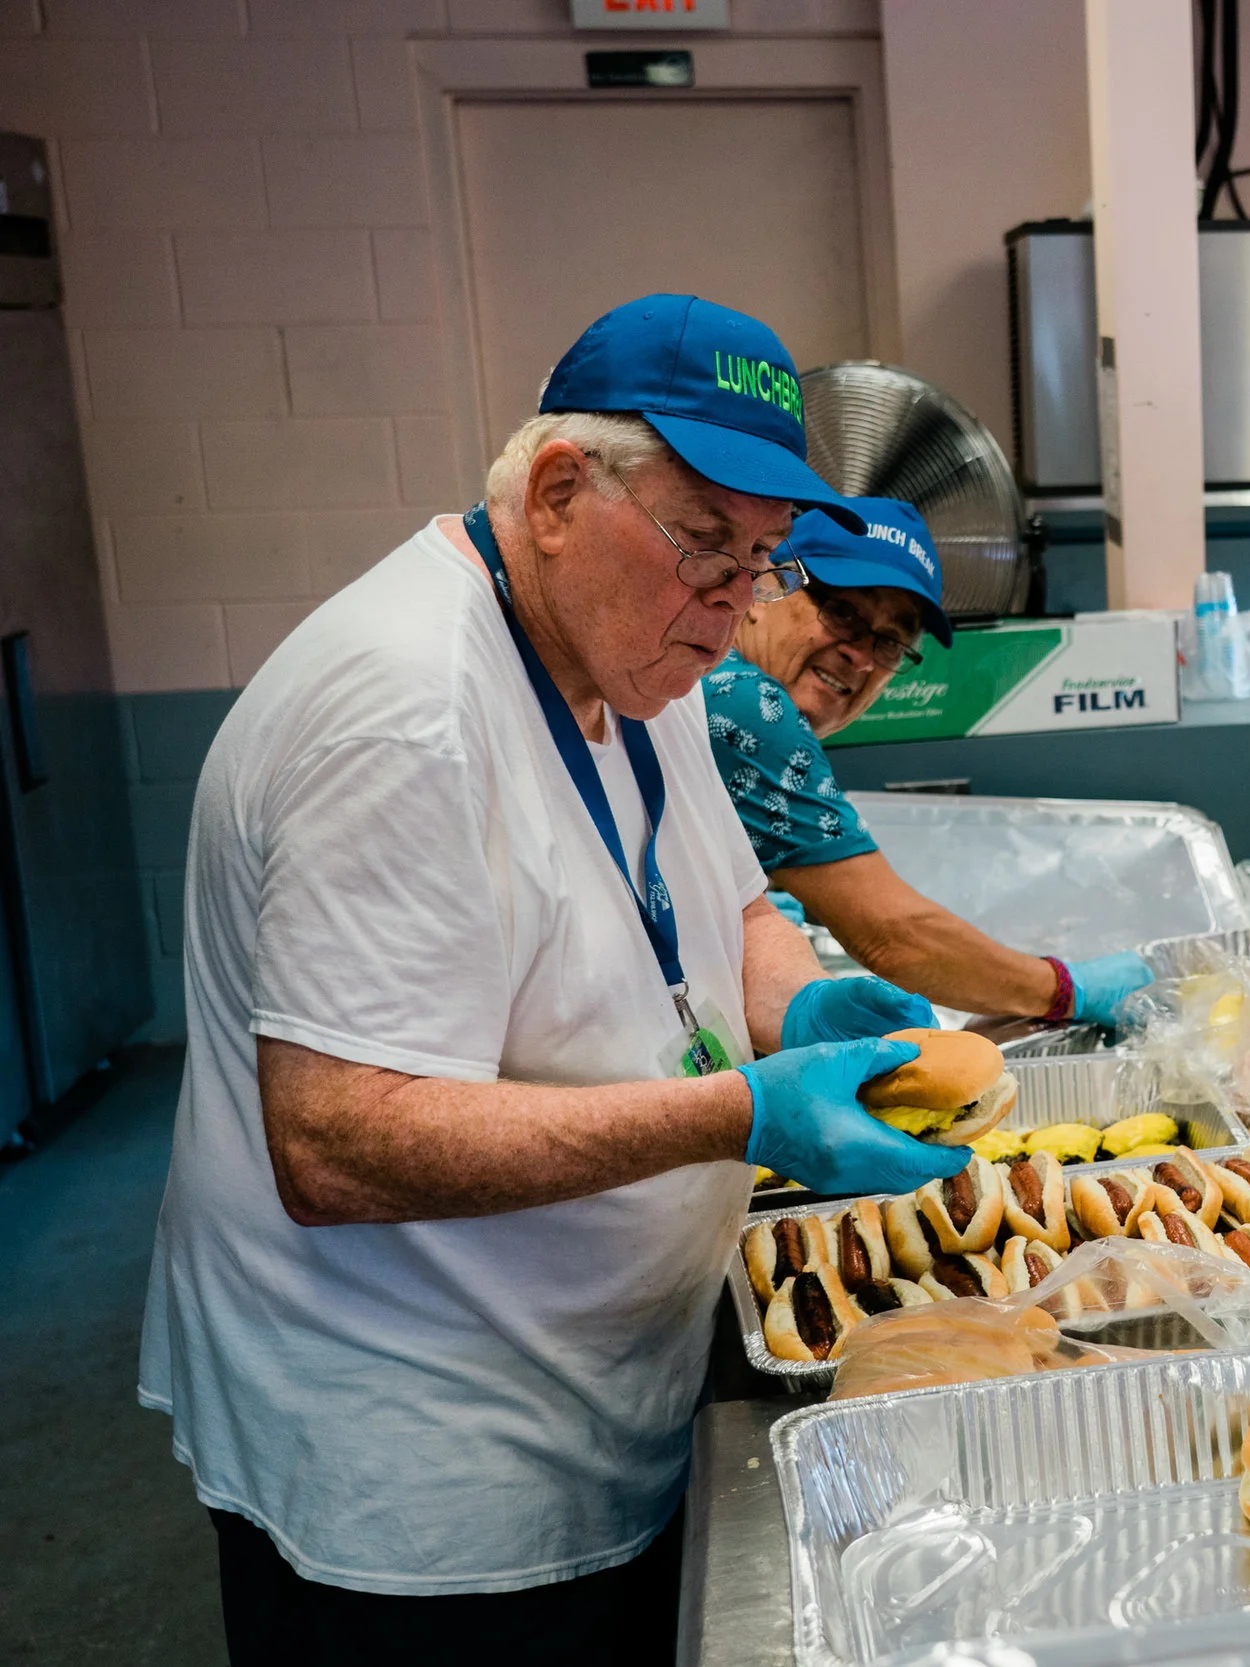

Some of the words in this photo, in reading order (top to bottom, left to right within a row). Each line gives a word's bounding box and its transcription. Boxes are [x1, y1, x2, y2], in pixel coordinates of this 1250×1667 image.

[866, 523, 906, 547] UNCH
[908, 537, 936, 579] BREAK
[1053, 689, 1146, 714] FILM
